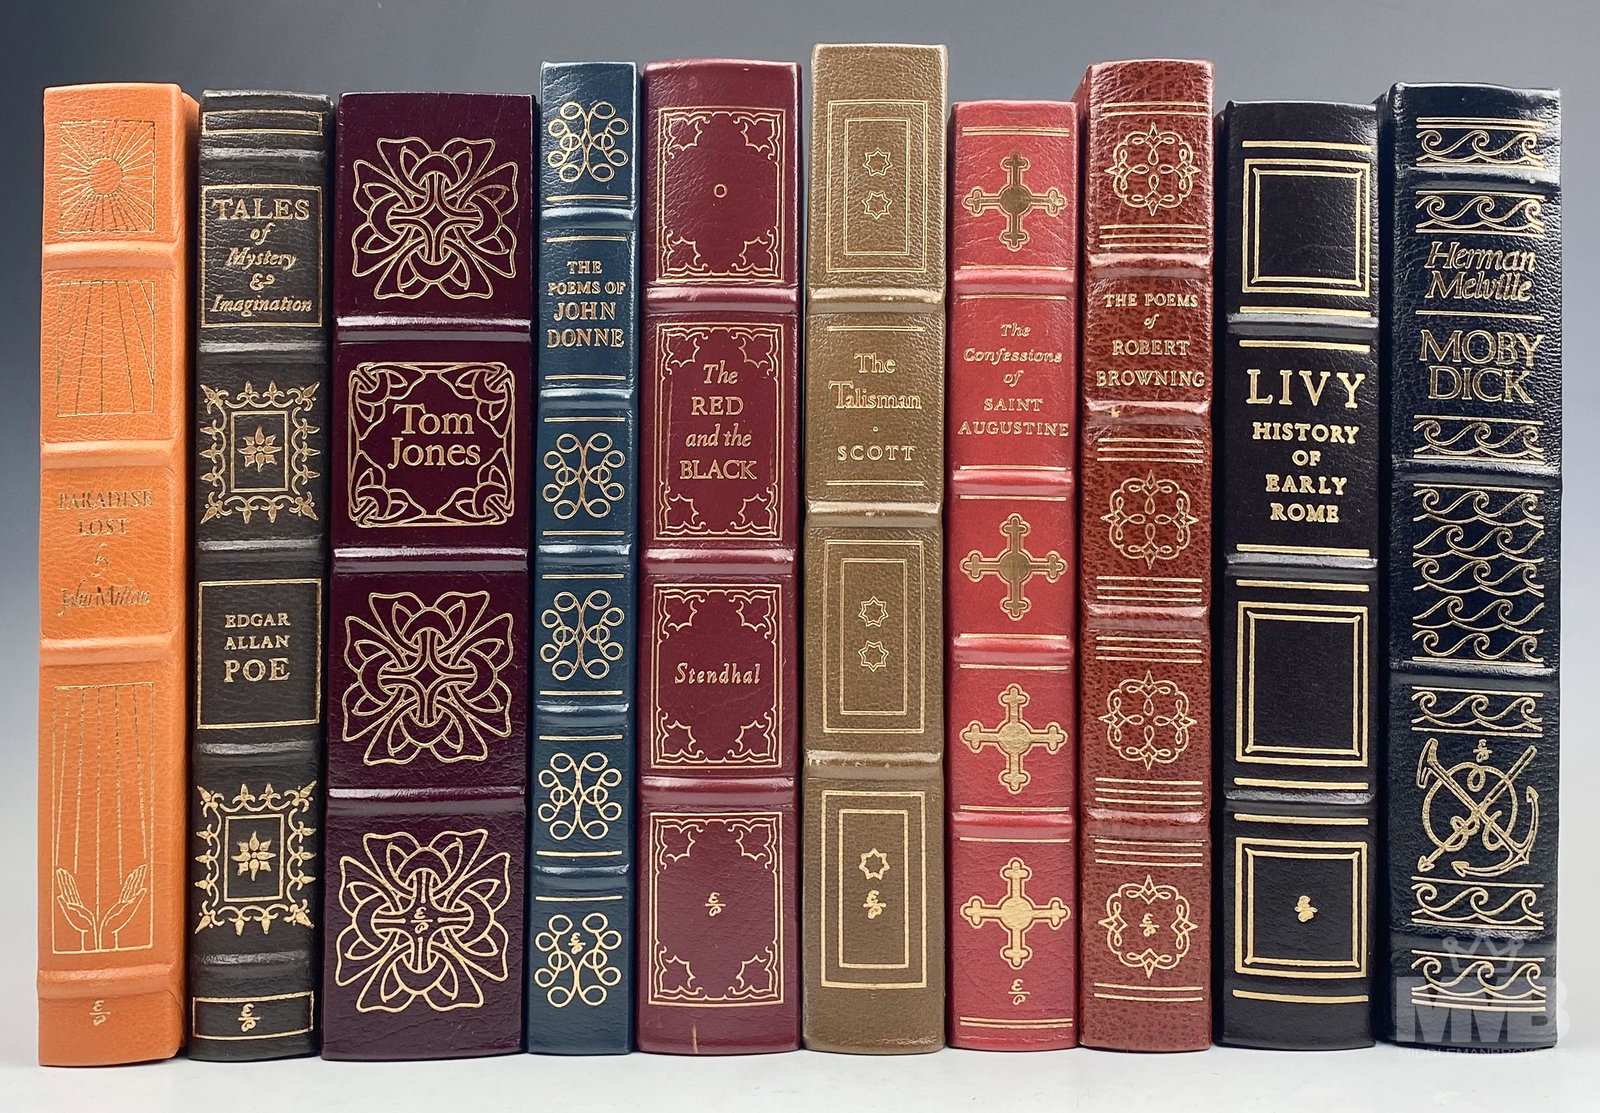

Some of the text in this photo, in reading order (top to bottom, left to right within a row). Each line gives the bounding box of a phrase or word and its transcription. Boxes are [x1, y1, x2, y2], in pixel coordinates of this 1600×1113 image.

[213, 197, 311, 222] TALES
[250, 222, 276, 246] of
[226, 247, 298, 271] Mystery
[1423, 240, 1537, 273] Herman
[566, 260, 603, 275] THE
[249, 273, 277, 291] &
[547, 281, 627, 296] POEMS OF
[1424, 270, 1534, 302] Melville
[210, 295, 314, 318] Imagination
[553, 301, 617, 321] JOHN
[1103, 293, 1200, 308] THE POEMS
[1000, 322, 1031, 337] The
[1143, 313, 1160, 330] of
[546, 328, 625, 348] DONNE
[1111, 339, 1191, 357] ROBERT
[1418, 328, 1546, 367] MOBY
[853, 351, 897, 374] The
[963, 347, 1063, 366] Confessions
[703, 359, 739, 385] The
[1002, 369, 1025, 388] of
[1095, 369, 1205, 388] BROWNING
[1245, 368, 1366, 409] LIVY
[1427, 364, 1536, 404] DICK
[827, 380, 922, 410] Talisman
[983, 398, 1044, 412] SAINT
[691, 396, 744, 416] RED
[392, 402, 476, 435] Tom
[957, 420, 1070, 437] AUGUSTINE
[685, 422, 752, 447] and the
[1252, 421, 1360, 445] HISTORY
[387, 436, 482, 470] Jones
[836, 444, 918, 461] SCOTT
[1291, 449, 1322, 467] OF
[679, 459, 758, 480] BLACK
[1265, 473, 1348, 496] EARLY
[58, 489, 153, 511] PARADISE
[1269, 502, 1340, 524] ROME
[78, 518, 130, 536] LOST
[224, 612, 292, 629] EDGAR
[223, 634, 292, 651] ALLAN
[223, 657, 291, 683] POE
[674, 662, 761, 685] Stendhal
